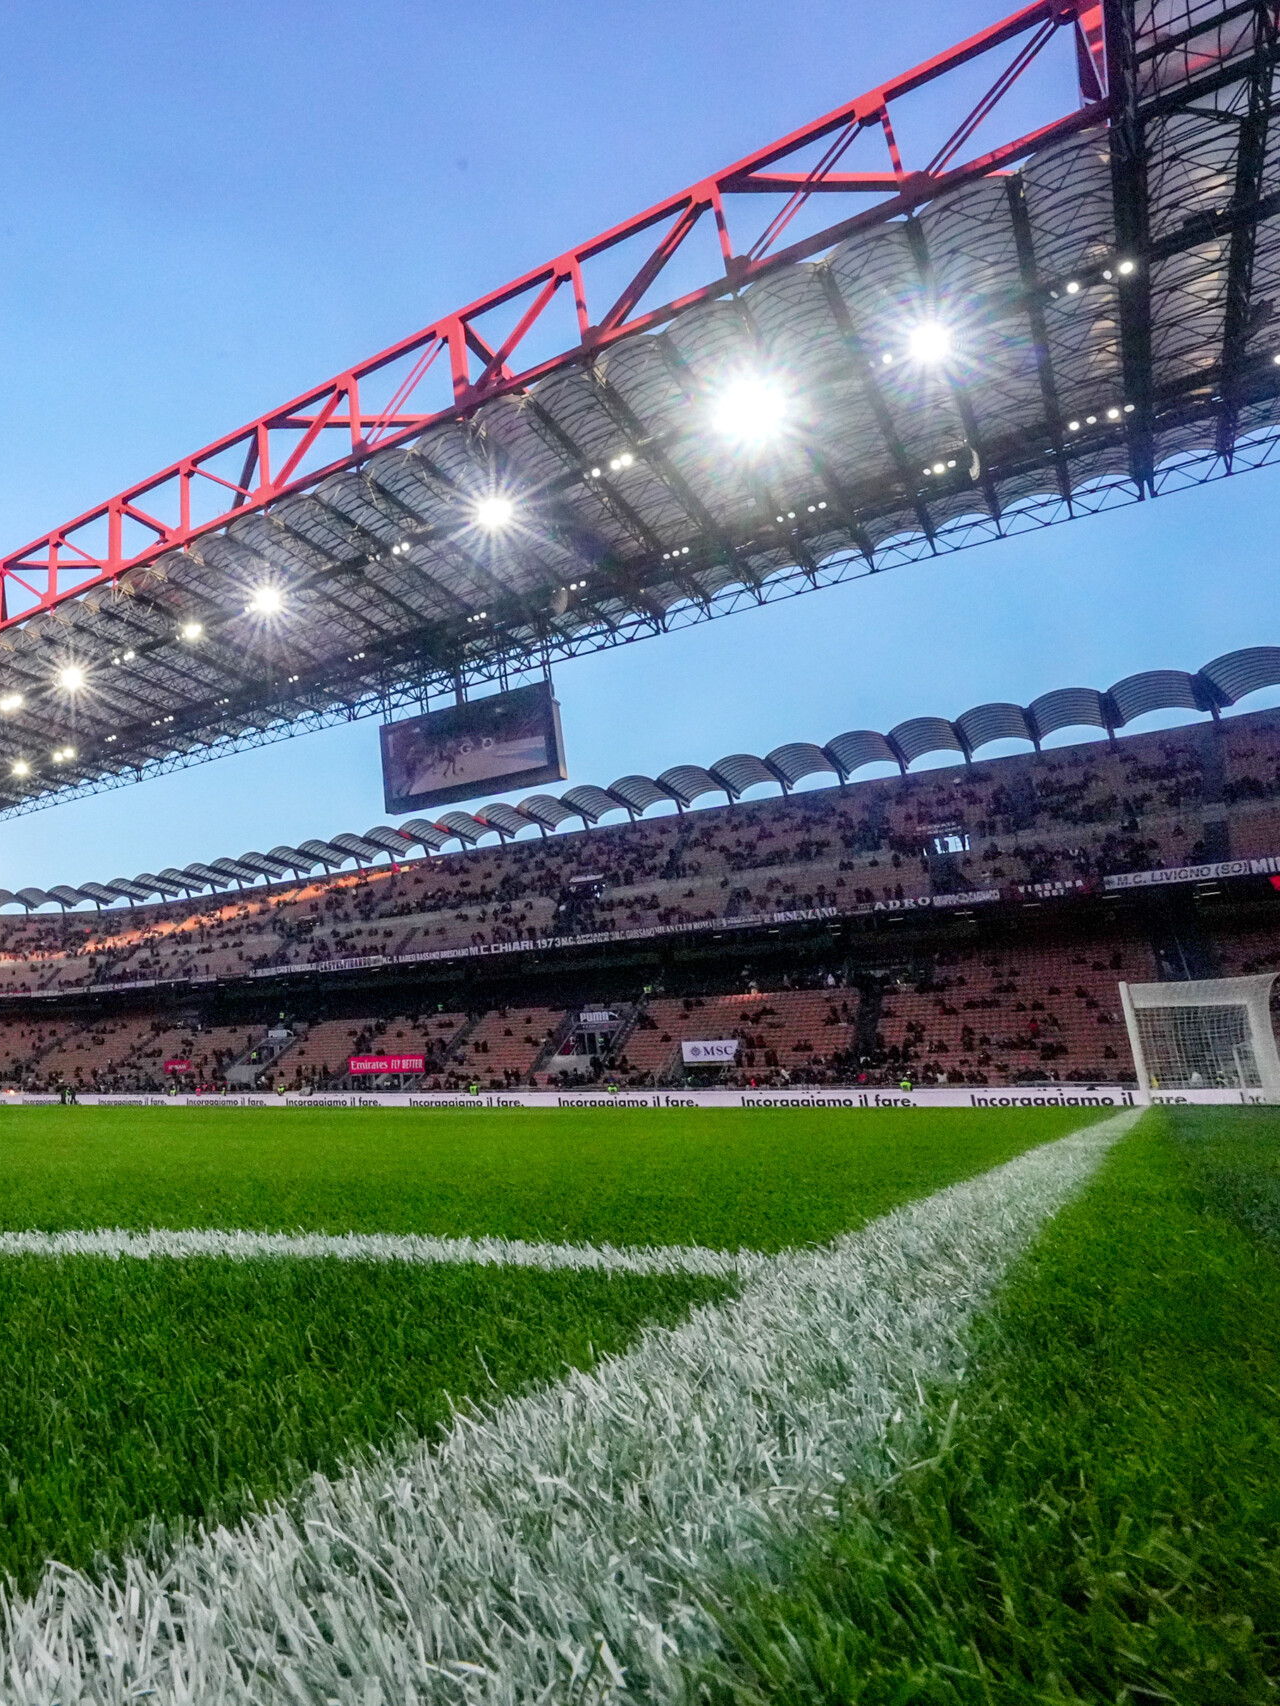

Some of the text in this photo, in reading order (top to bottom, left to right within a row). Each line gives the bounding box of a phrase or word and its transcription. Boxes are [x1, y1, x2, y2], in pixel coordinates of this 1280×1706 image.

[1152, 866, 1210, 882] LIVIGNO
[1216, 862, 1250, 876] (SO)
[1250, 857, 1280, 874] MI
[874, 896, 930, 910] ADRO
[491, 939, 534, 954] CHIARI
[536, 937, 561, 949] 1973
[579, 1011, 609, 1022] PUMA
[703, 1046, 734, 1057] MSC
[350, 1058, 423, 1070] Emirates FLY BETTER
[1122, 1092, 1134, 1107] il
